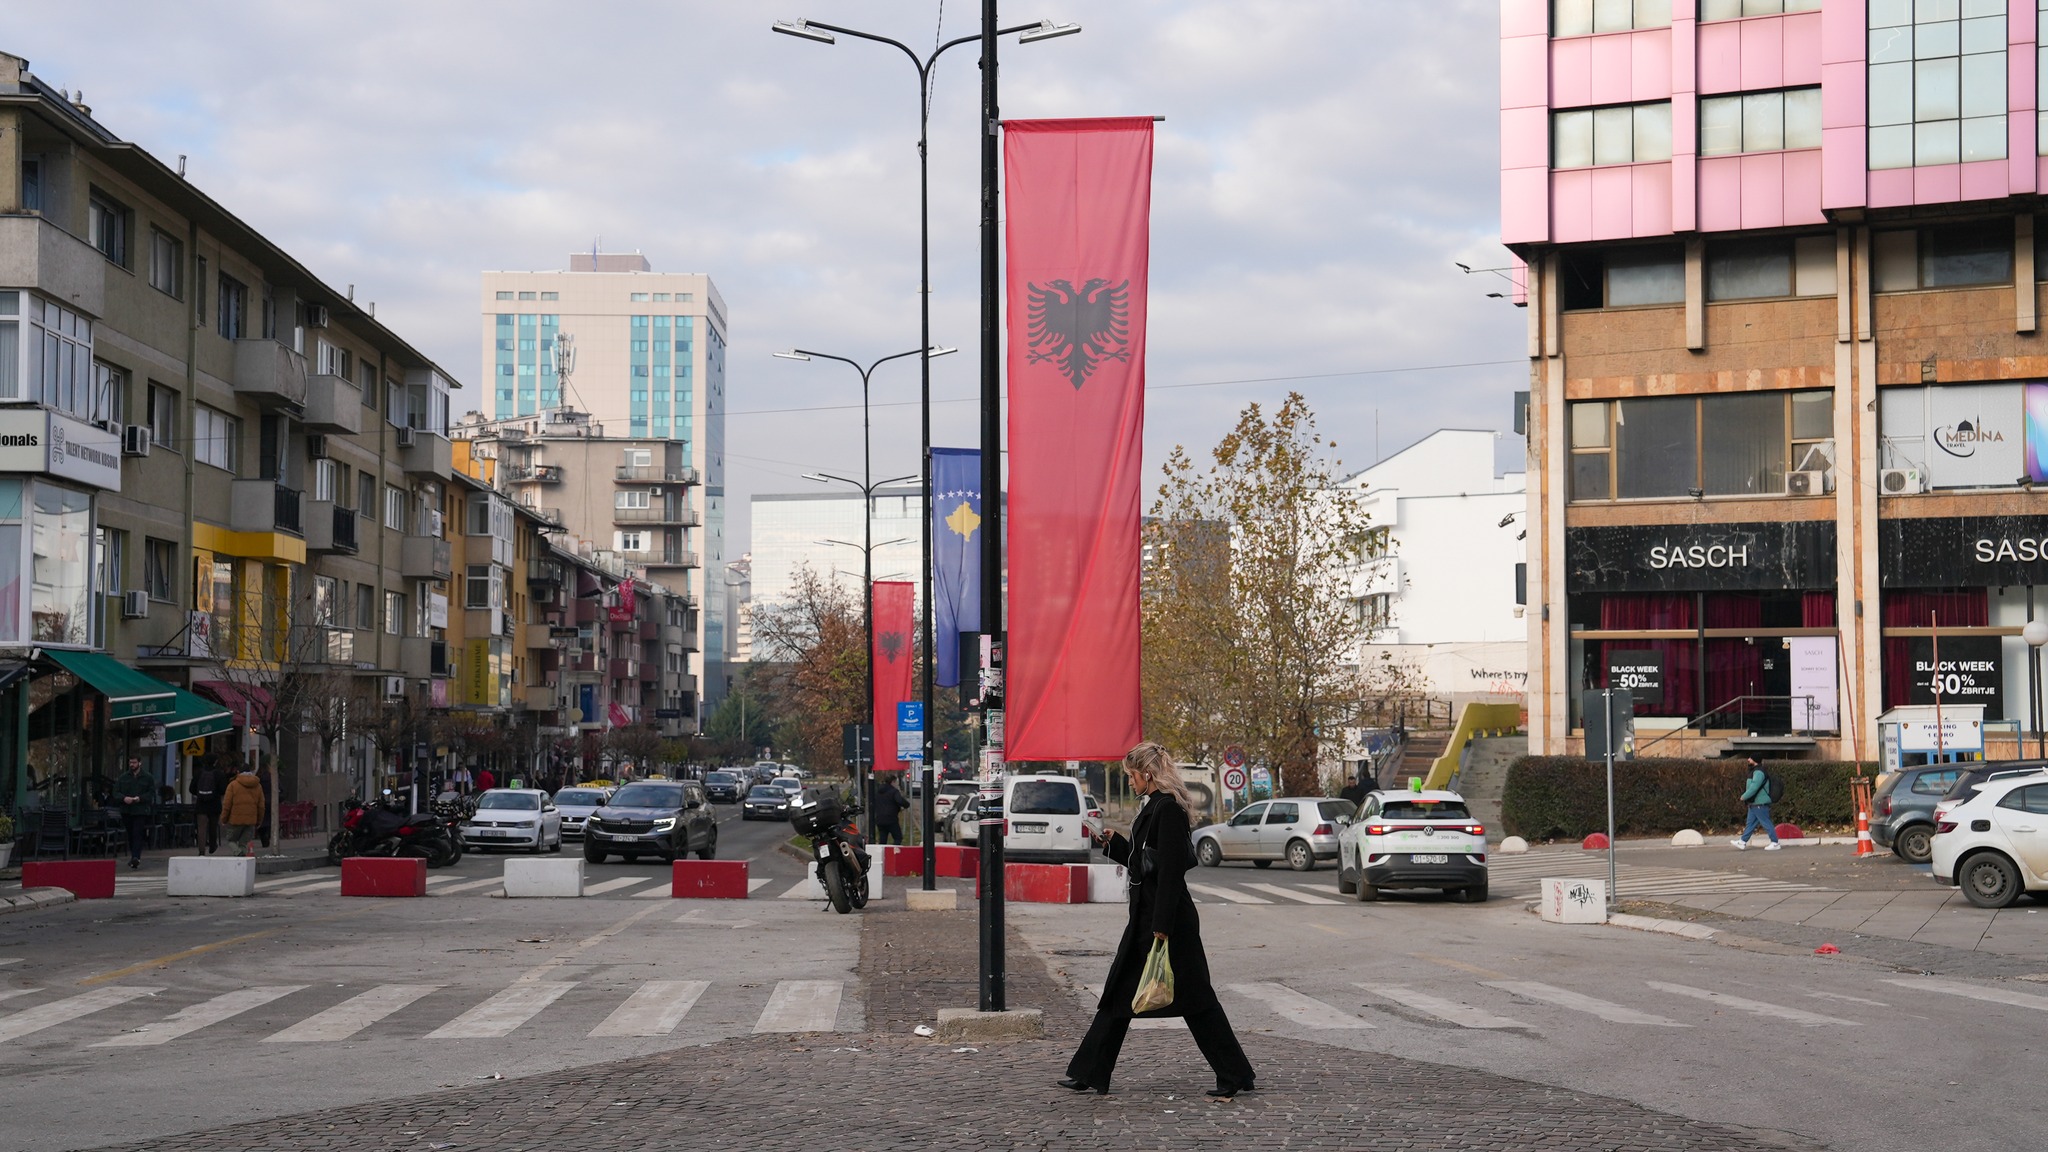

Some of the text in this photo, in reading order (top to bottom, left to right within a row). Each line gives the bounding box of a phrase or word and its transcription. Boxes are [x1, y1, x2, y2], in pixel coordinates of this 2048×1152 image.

[1946, 430, 2004, 442] MEDINA
[65, 440, 118, 470] TALENT NETWORK KOSOVA
[1649, 544, 1747, 569] SASCH
[1611, 665, 1658, 673] BLACK WEEK
[1916, 661, 1995, 672] BLACK WEEK
[1471, 668, 1502, 679] Where
[1514, 671, 1528, 686] my
[1620, 674, 1647, 688] 50%
[1930, 673, 1975, 695] 50%
[1961, 687, 1995, 695] ZBRITJE
[1229, 774, 1241, 785] 20
